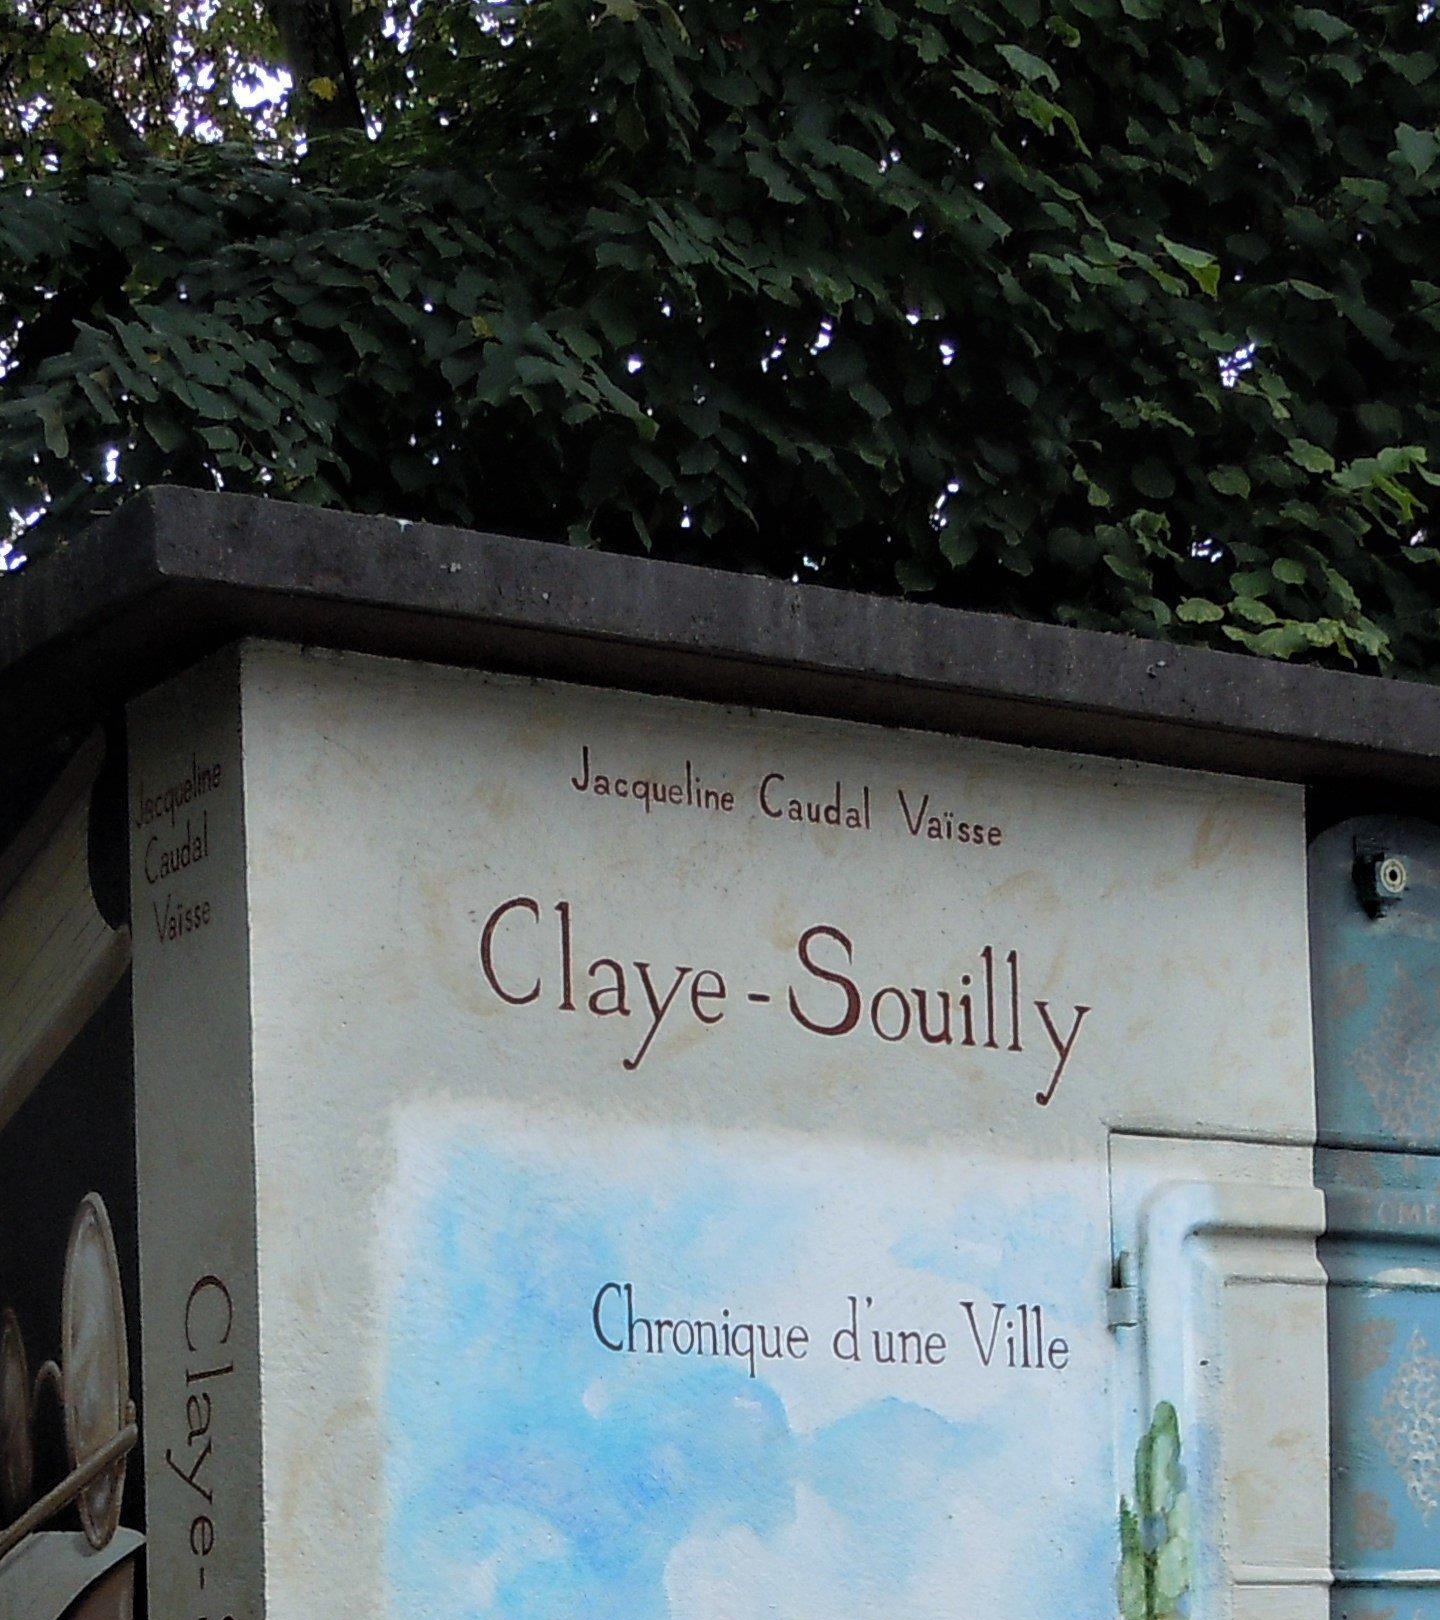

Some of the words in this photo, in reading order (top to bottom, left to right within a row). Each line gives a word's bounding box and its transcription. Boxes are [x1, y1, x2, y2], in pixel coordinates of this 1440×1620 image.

[134, 752, 222, 829] Jacqueline
[571, 745, 735, 813] Jacqueline
[759, 773, 872, 831] Caudal
[897, 790, 1003, 848] Vaïsse
[144, 810, 210, 885] Caudal
[479, 897, 1091, 1105] Claye-Souilly
[592, 1282, 809, 1378] Chronique
[831, 1296, 947, 1366] d'une
[960, 1301, 1070, 1371] Ville
